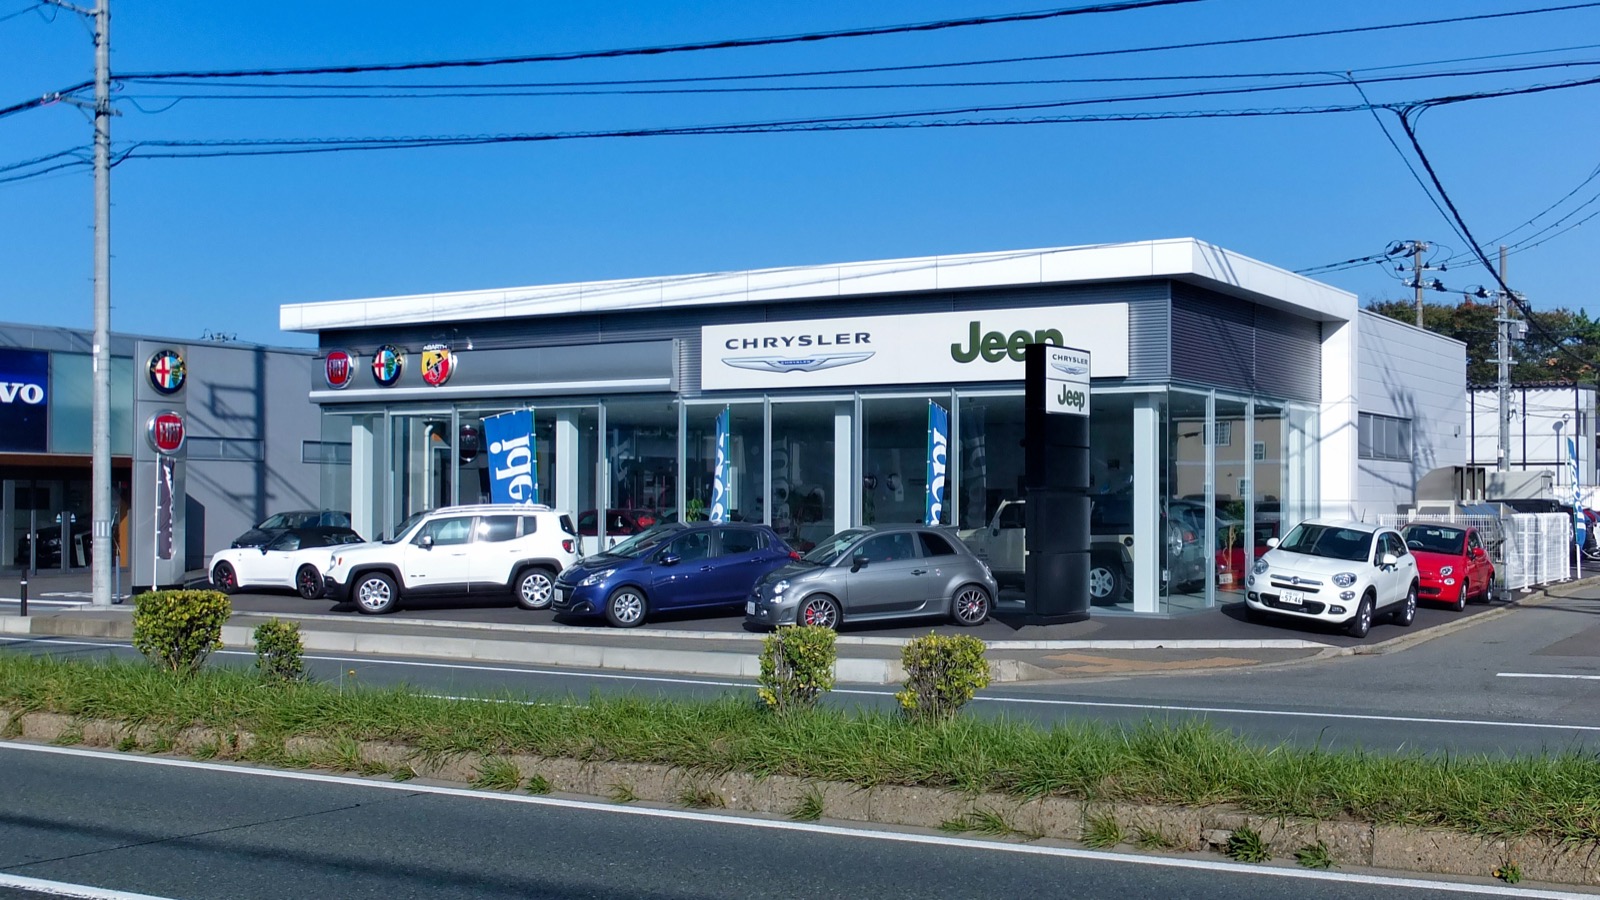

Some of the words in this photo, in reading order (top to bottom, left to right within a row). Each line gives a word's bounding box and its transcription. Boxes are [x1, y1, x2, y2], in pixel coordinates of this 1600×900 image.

[725, 332, 871, 350] CHRYSLER
[1052, 353, 1088, 365] CHRYSLER
[1057, 384, 1085, 412] Jeep
[159, 422, 181, 443] FIAT
